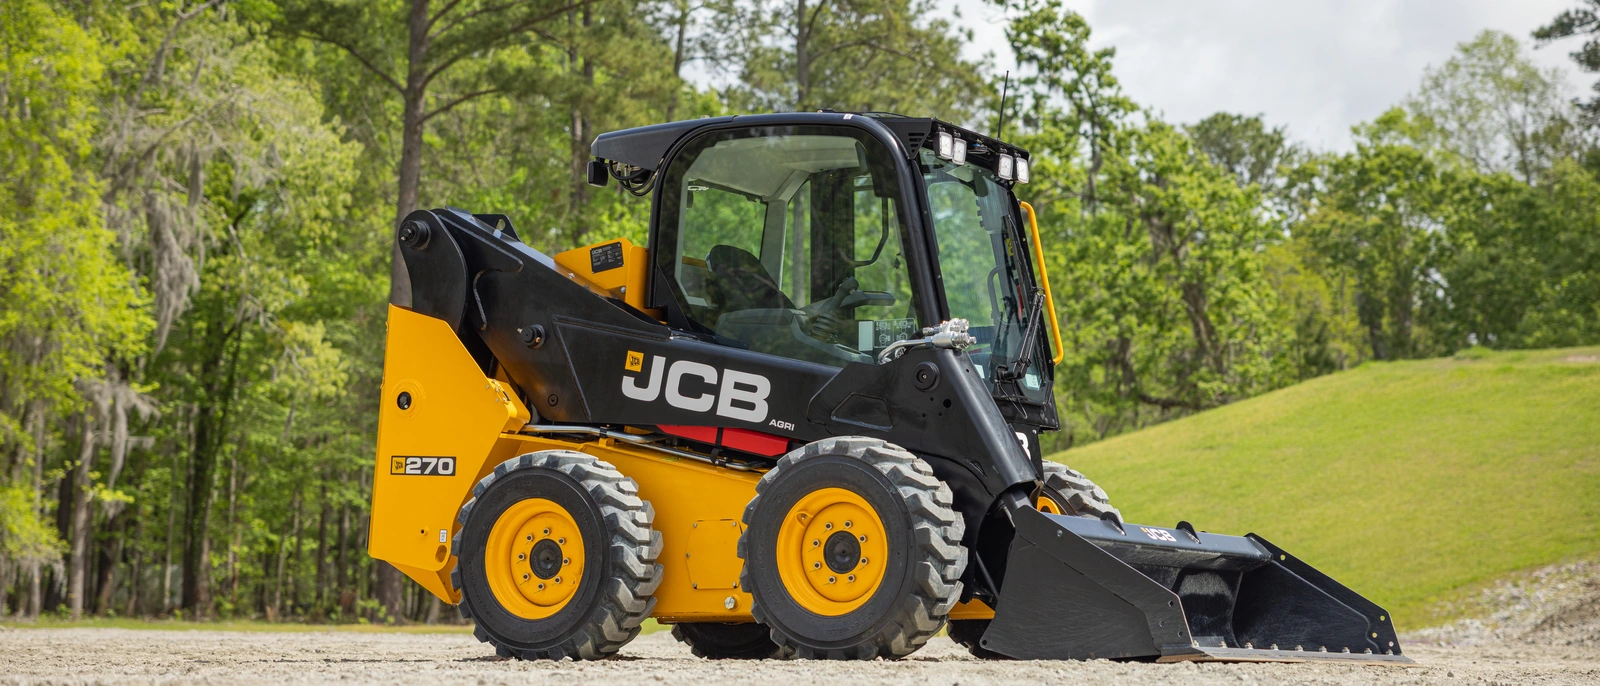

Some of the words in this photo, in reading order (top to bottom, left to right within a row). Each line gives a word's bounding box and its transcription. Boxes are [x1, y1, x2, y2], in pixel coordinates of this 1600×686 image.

[630, 355, 641, 366] JCB
[622, 355, 771, 423] JCB
[769, 419, 795, 431] AGRI
[406, 457, 453, 474] 270
[1144, 527, 1177, 542] JCB
